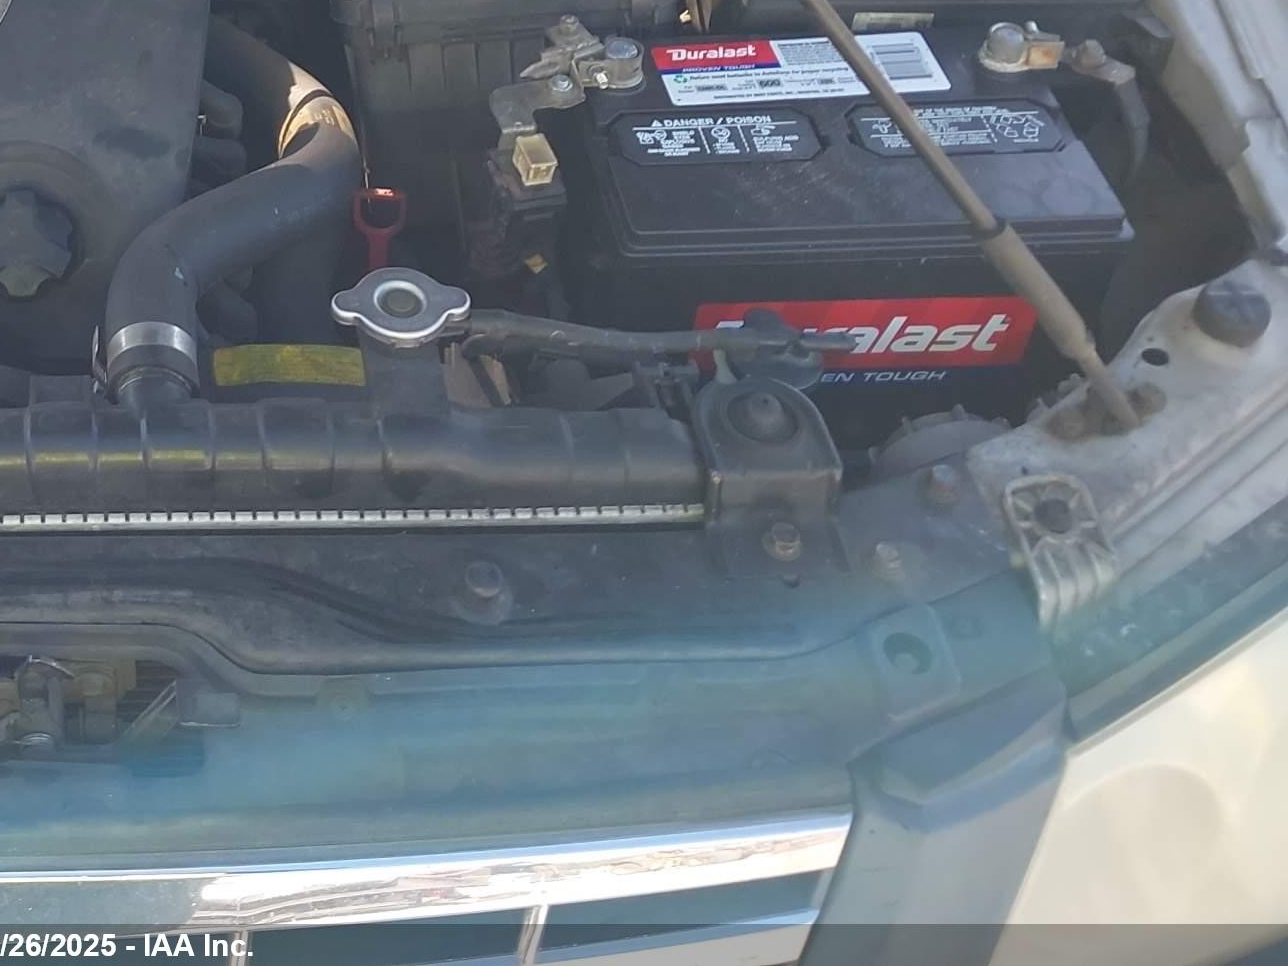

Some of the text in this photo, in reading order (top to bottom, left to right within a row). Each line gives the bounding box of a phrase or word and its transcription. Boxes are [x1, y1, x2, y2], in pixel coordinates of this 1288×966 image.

[666, 44, 757, 61] Duralast
[663, 117, 713, 127] DANGER
[725, 115, 772, 125] POISON
[863, 370, 947, 383] TOUGH
